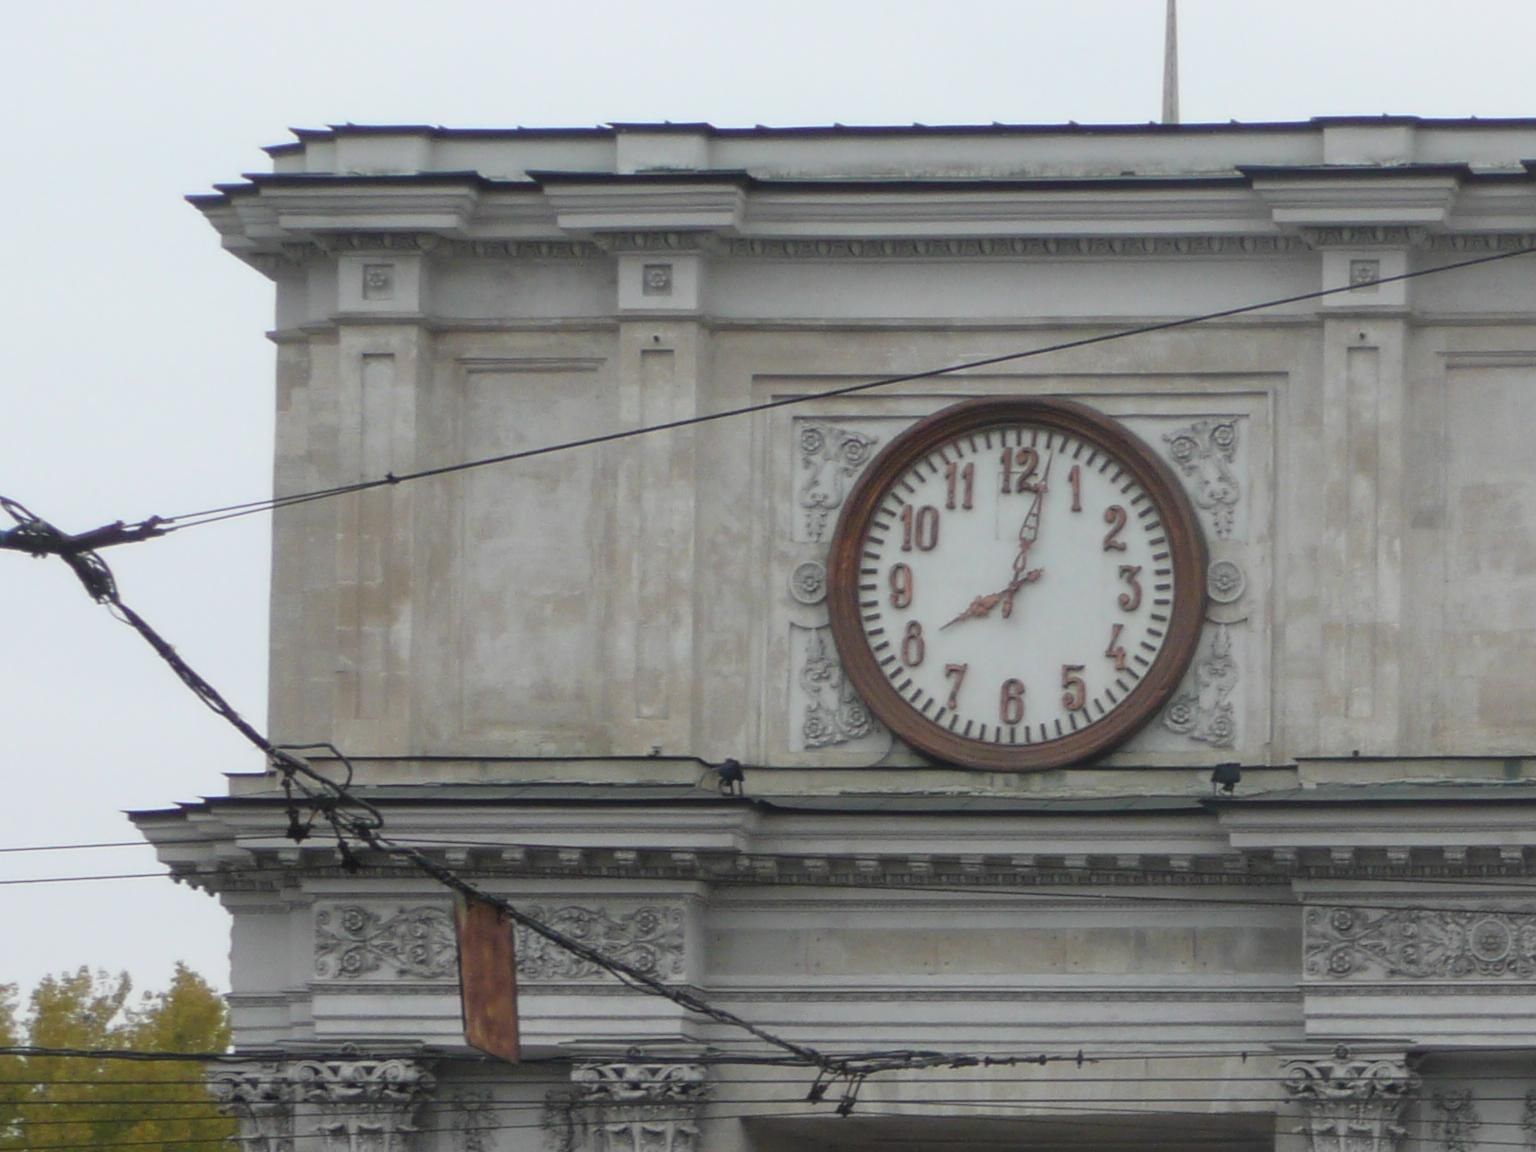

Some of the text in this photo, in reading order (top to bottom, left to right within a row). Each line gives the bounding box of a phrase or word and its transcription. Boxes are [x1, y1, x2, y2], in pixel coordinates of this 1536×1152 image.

[944, 462, 975, 511] 11
[1000, 447, 1045, 494] 12
[1068, 465, 1082, 512] 1
[900, 504, 940, 552] 10
[1104, 505, 1127, 551] 2
[889, 562, 913, 609] 9
[1118, 565, 1143, 611] 3
[902, 620, 925, 667] 8
[1106, 623, 1126, 670] 4
[944, 663, 968, 709] 7
[1000, 678, 1025, 725] 6
[1062, 664, 1086, 711] 5
